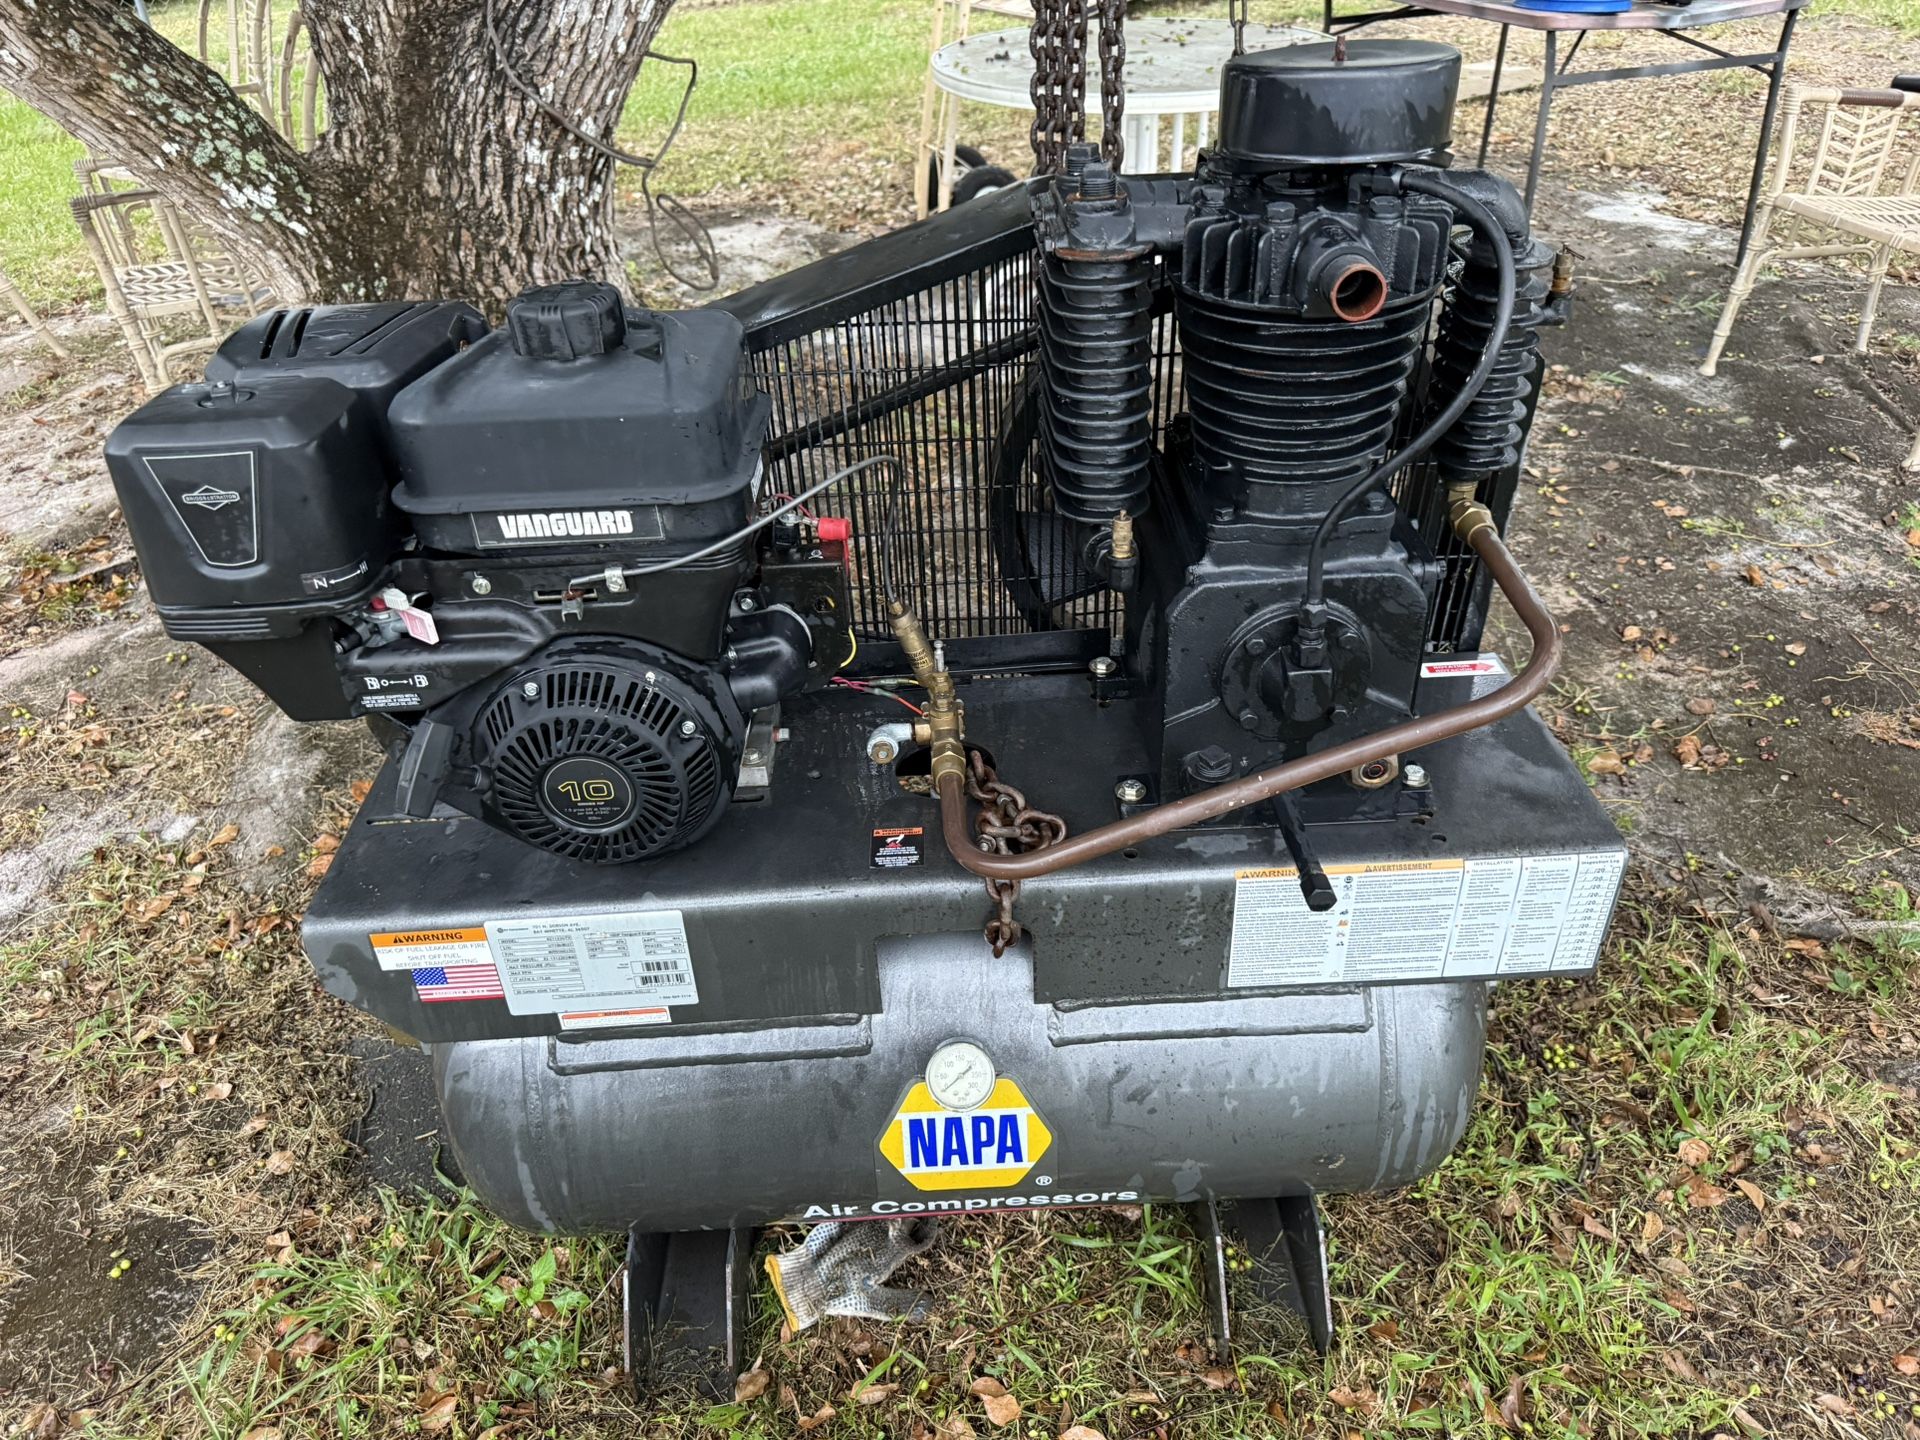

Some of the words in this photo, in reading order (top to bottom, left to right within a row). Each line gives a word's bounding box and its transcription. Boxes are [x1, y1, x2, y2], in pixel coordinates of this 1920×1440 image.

[497, 510, 634, 539] VANGUARD
[558, 780, 614, 800] 10
[1248, 869, 1299, 878] WARNIN
[1373, 862, 1433, 872] AVERTISSEMENT
[402, 932, 463, 943] WARNING
[424, 958, 478, 967] TRANSPORTING
[908, 1114, 1023, 1168] NAPA
[803, 1204, 858, 1218] Air
[872, 1190, 1139, 1214] Compressors
